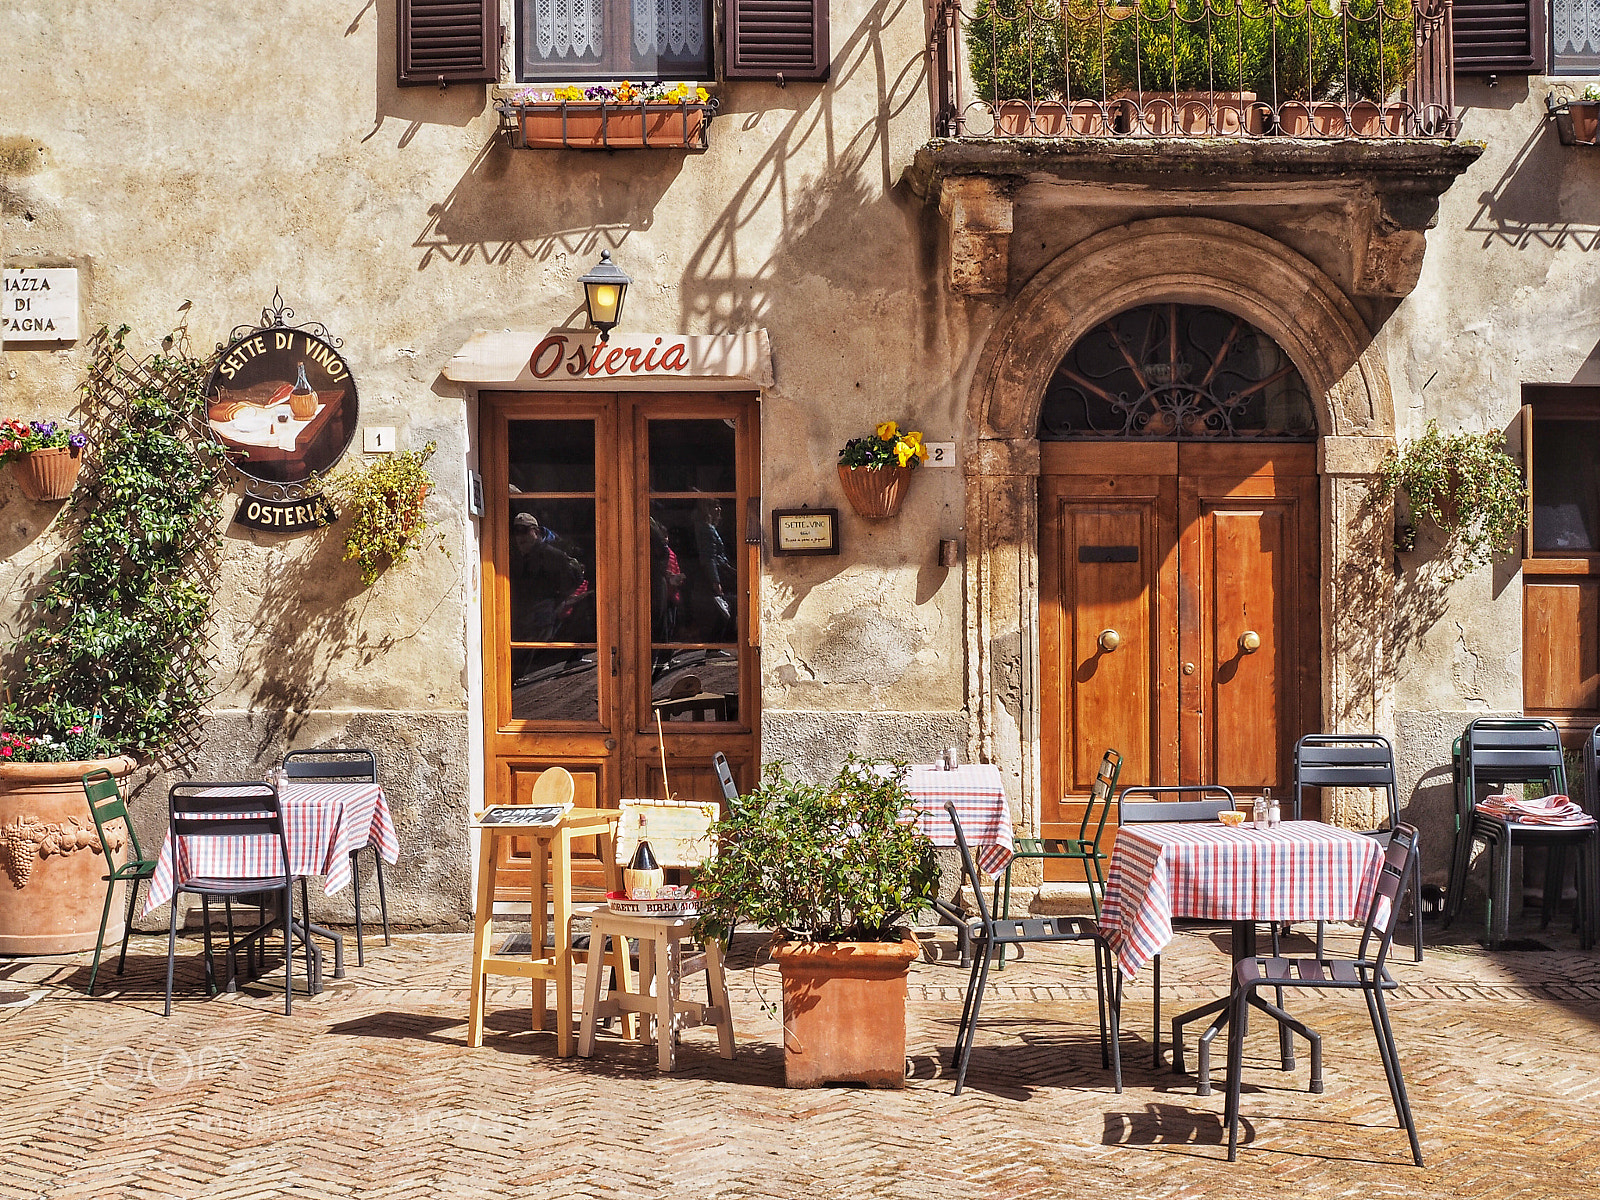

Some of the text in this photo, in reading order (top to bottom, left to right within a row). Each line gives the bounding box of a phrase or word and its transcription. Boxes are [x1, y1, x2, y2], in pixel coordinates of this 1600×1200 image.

[15, 298, 31, 311] DI
[220, 332, 349, 383] SETTE DI VINO!
[529, 335, 690, 379] Osteria
[375, 433, 382, 447] 1
[935, 448, 944, 461] 2
[646, 902, 677, 912] BIRRA
